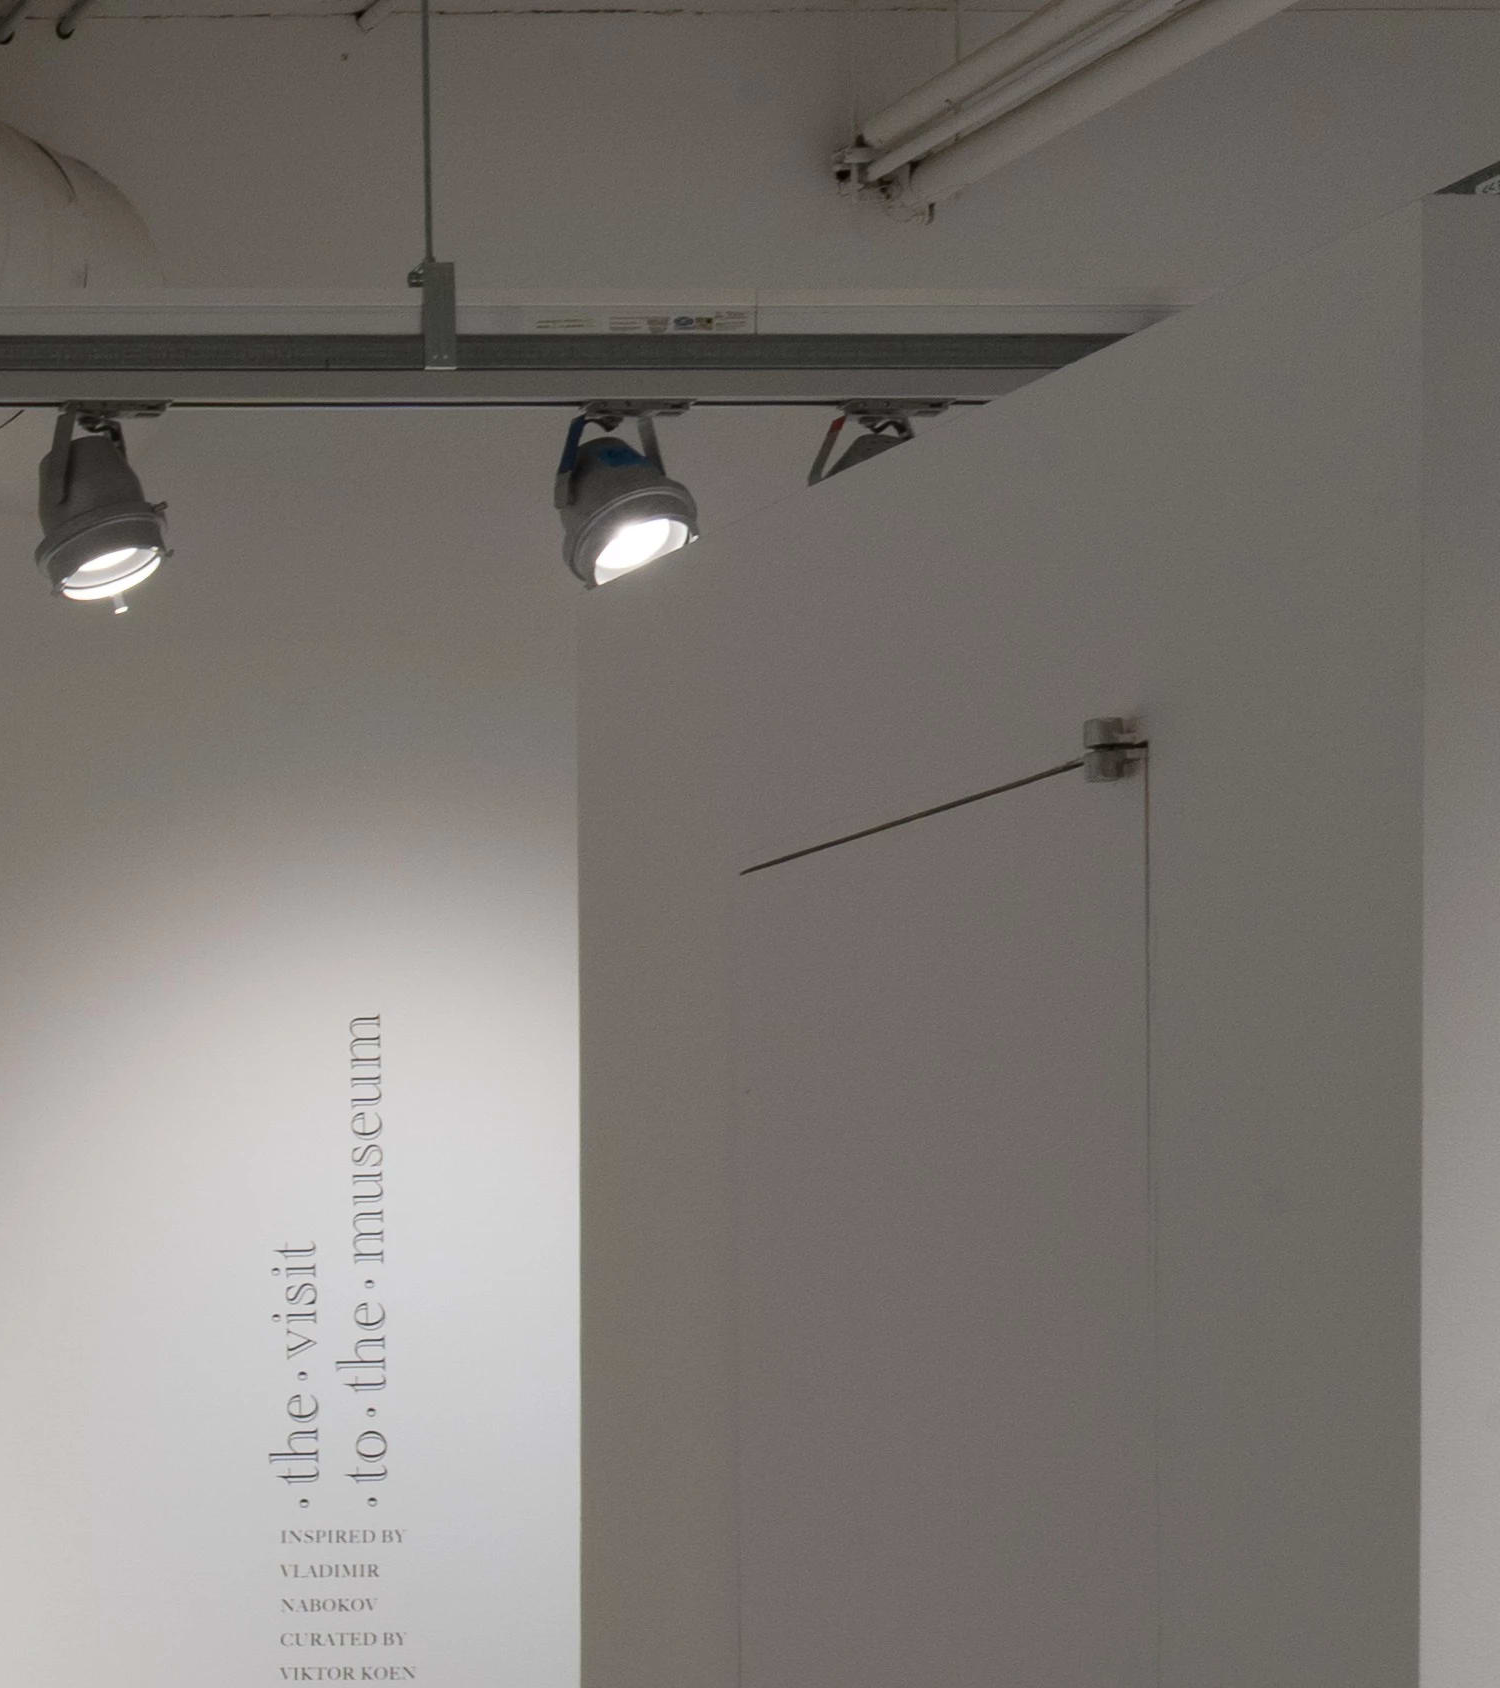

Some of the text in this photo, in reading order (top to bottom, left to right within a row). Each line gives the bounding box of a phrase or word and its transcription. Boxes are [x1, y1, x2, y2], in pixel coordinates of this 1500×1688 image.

[349, 1013, 385, 1265] museum
[280, 1529, 408, 1544] INSPIRED BY
[279, 1563, 381, 1578] VLADIMIR
[280, 1598, 378, 1613] NABOKOV
[280, 1632, 408, 1647] CURATED BY
[279, 1666, 417, 1681] VIKTOR KOEN
